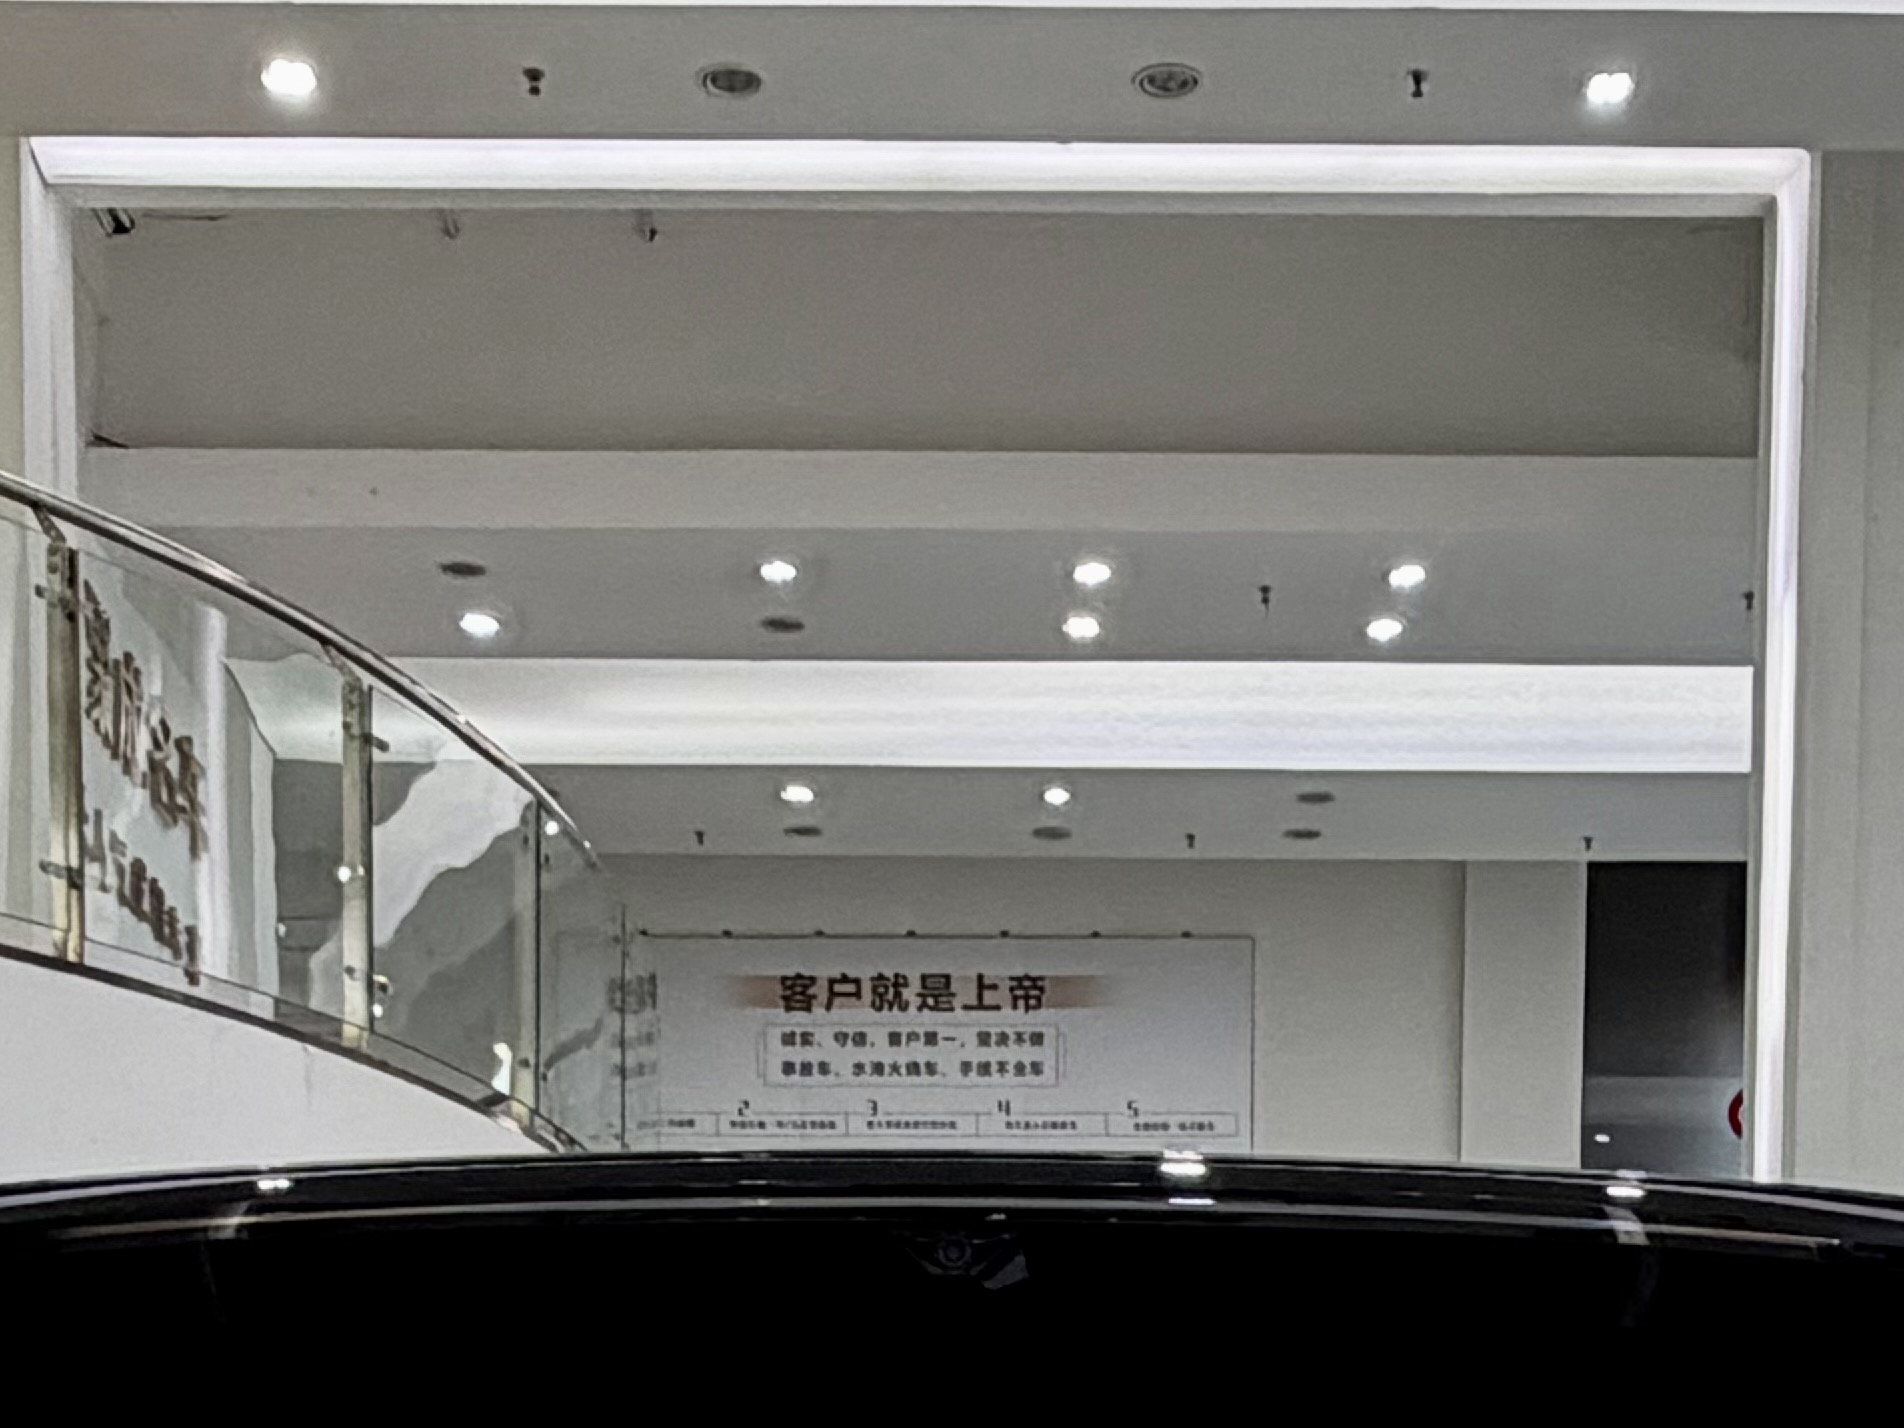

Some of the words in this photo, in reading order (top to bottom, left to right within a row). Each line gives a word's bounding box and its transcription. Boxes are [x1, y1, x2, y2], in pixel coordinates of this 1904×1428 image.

[779, 972, 1046, 1013] 客户就是上帝
